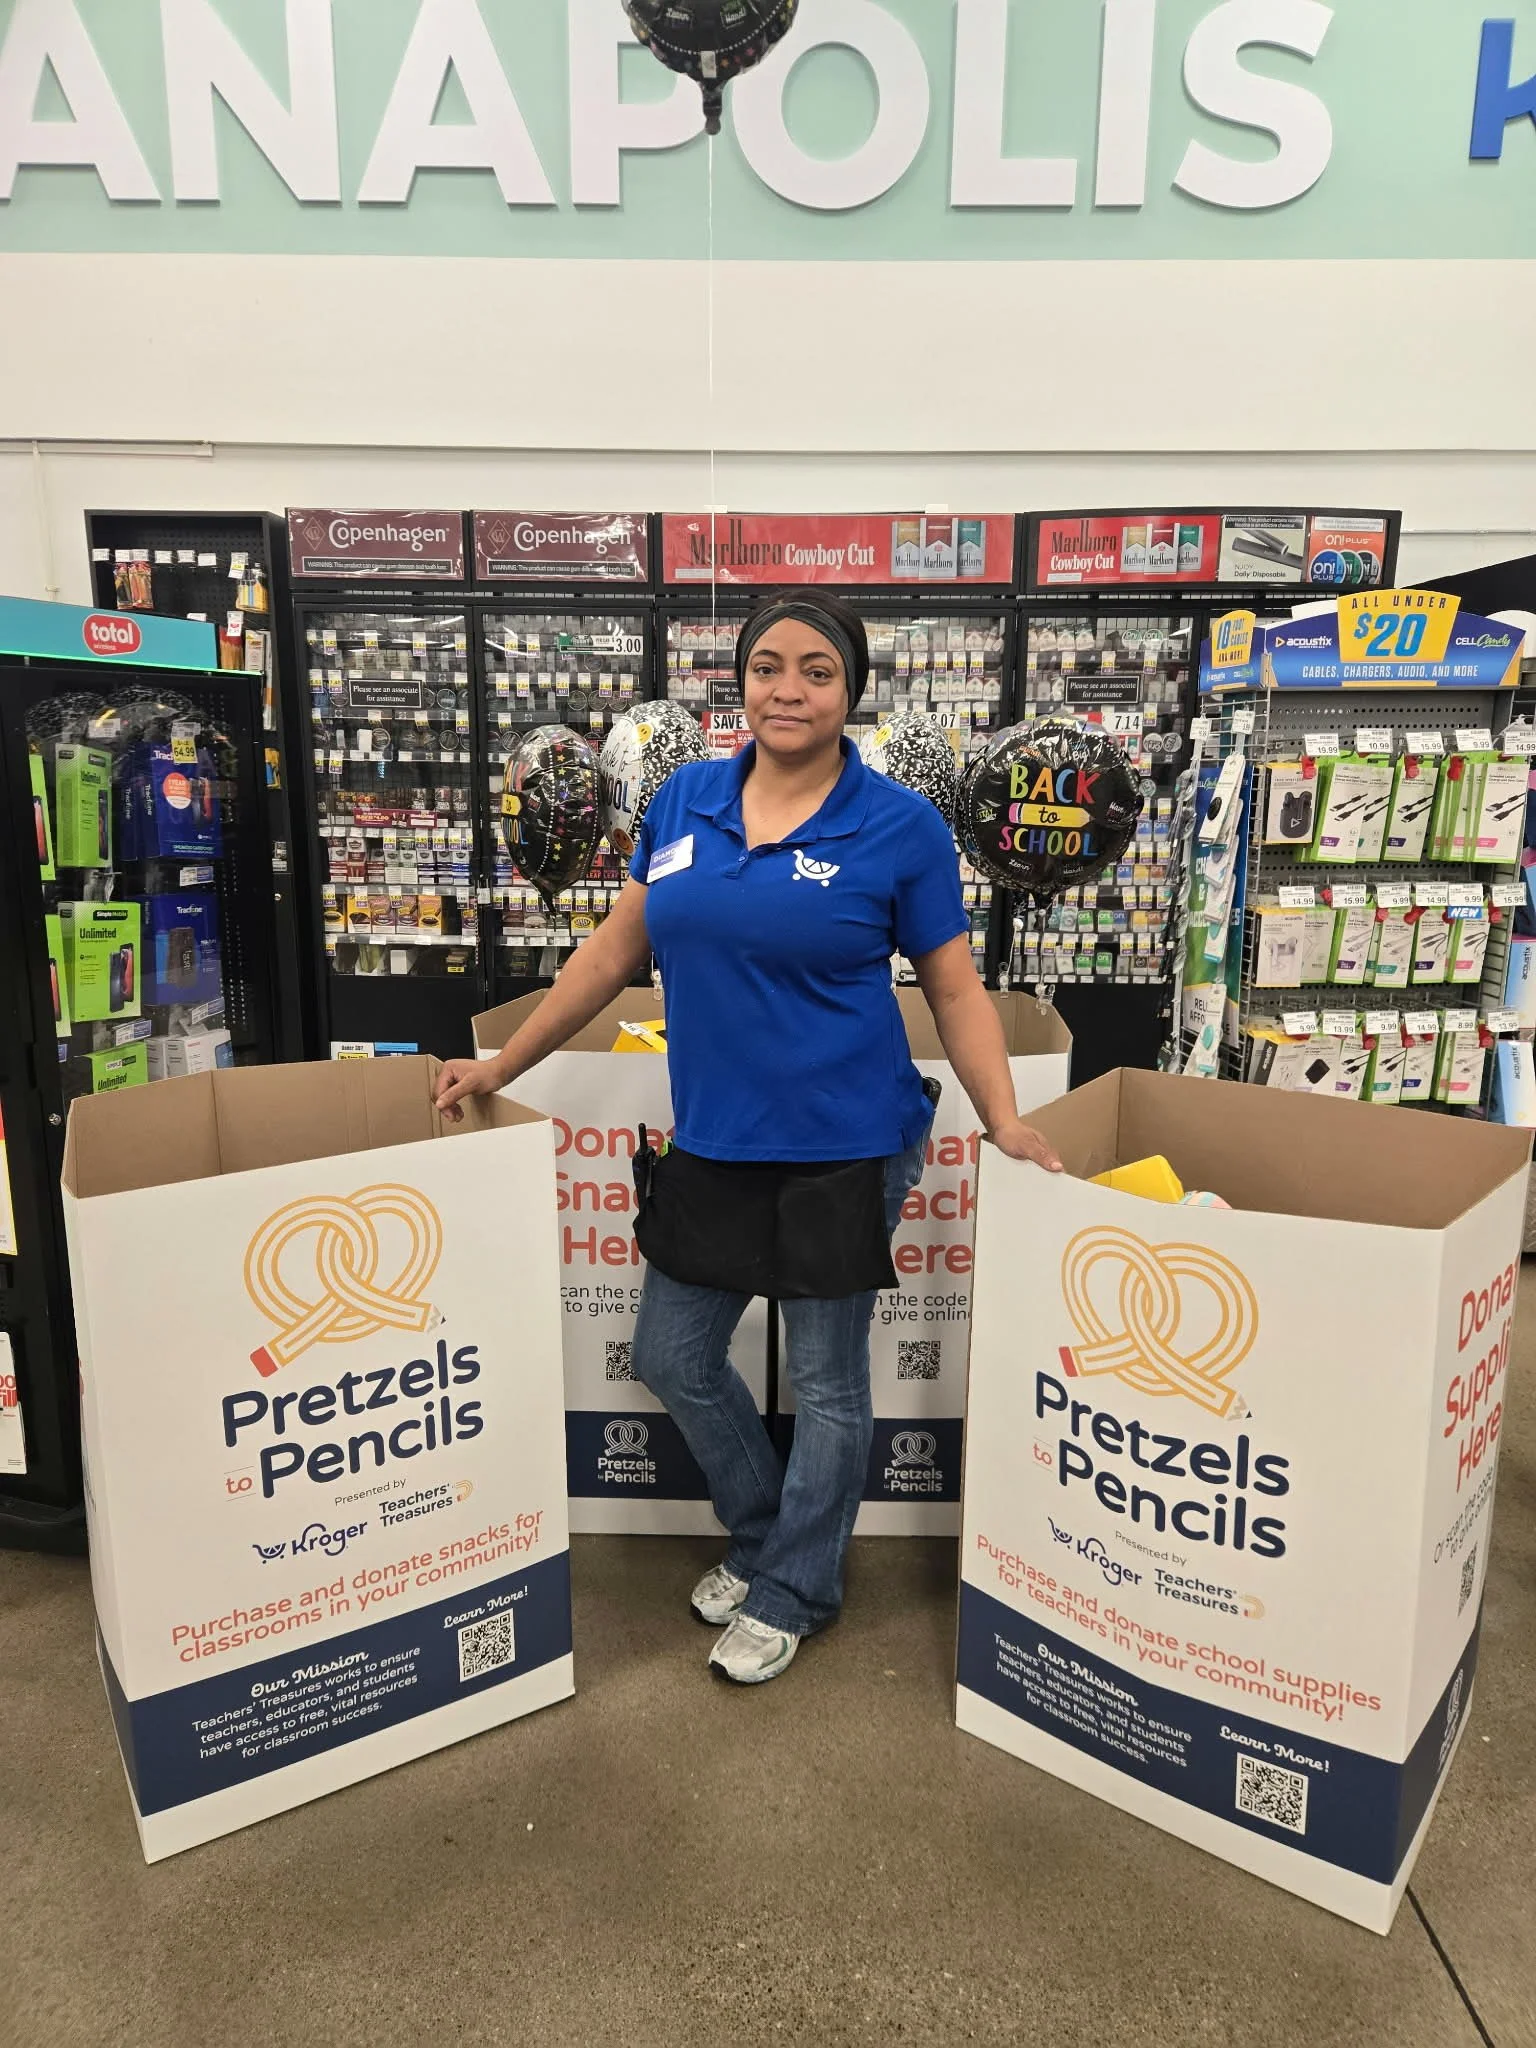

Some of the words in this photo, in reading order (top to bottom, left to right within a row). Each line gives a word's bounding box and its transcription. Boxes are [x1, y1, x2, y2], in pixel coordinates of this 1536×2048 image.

[329, 519, 446, 551] Copenhagen
[514, 522, 630, 554] Copenhagen
[690, 519, 782, 566] Marlboro
[785, 543, 844, 570] Cowboy
[848, 544, 874, 565] Cut
[1052, 520, 1116, 553] Marlboro
[1051, 555, 1092, 573] Cowboy
[1095, 554, 1114, 569] Cut
[1352, 596, 1379, 609] ALL
[1393, 595, 1446, 609] UNDER
[91, 621, 134, 645] total
[616, 638, 641, 652] 3.00
[1287, 636, 1332, 646] acoustix
[1353, 612, 1427, 657] $20
[1431, 665, 1450, 677] AND
[1453, 665, 1478, 677] MORE
[714, 715, 742, 729] SAVE
[1116, 716, 1140, 730] 7.14
[1010, 763, 1100, 804] BACK
[1039, 807, 1060, 824] to
[999, 826, 1098, 856] SCHOOL
[1009, 859, 1030, 870] Learn
[177, 906, 202, 915] Tracfone
[1450, 908, 1479, 917] NEW
[80, 928, 117, 939] Unlimited
[98, 1073, 127, 1090] Unlimited
[895, 1243, 973, 1274] ere
[596, 1285, 623, 1299] the
[889, 1293, 918, 1306] the
[923, 1293, 967, 1307] code
[565, 1300, 582, 1313] to
[589, 1300, 625, 1317] give
[881, 1309, 918, 1324] give
[222, 1339, 481, 1447] Pretzels
[226, 1476, 252, 1495] to
[260, 1396, 484, 1498] Pencils
[1036, 1371, 1289, 1496] Pretzels
[1456, 1401, 1502, 1494] Here
[598, 1457, 656, 1470] Pretzels
[605, 1471, 656, 1483] Pencils
[884, 1468, 943, 1480] Pretzels
[334, 1482, 390, 1506] Presented
[393, 1478, 406, 1491] by
[379, 1483, 450, 1514] Teachers'
[891, 1480, 943, 1492] Pencils
[1033, 1443, 1052, 1466] to
[1059, 1439, 1286, 1558] Pencils
[380, 1495, 453, 1527] Treasures
[291, 1523, 367, 1556] Kroger
[1115, 1531, 1169, 1560] Presented
[1172, 1552, 1188, 1567] by
[172, 1596, 291, 1645] Purchase
[300, 1577, 345, 1606] and
[352, 1552, 432, 1589] donate
[439, 1523, 509, 1560] snacks
[515, 1509, 543, 1534] for
[1077, 1538, 1142, 1586] Kroger
[179, 1609, 322, 1662] classrooms
[329, 1598, 350, 1616] in
[358, 1580, 409, 1611] your
[415, 1527, 539, 1588] community!
[1155, 1568, 1237, 1600] Teachers'
[1155, 1581, 1238, 1616] Treasures
[443, 1606, 485, 1628] Learn
[488, 1586, 529, 1610] More!
[977, 1534, 1057, 1592] Purchase
[1062, 1583, 1098, 1614] and
[1104, 1607, 1179, 1651] donate
[1186, 1639, 1265, 1677] school
[1272, 1664, 1381, 1711] supplies
[997, 1564, 1025, 1592] for
[1027, 1583, 1107, 1637] teachers
[1113, 1629, 1131, 1651] in
[1136, 1646, 1189, 1673] your
[1195, 1662, 1344, 1723] community!
[192, 1703, 256, 1732] Teachers'
[259, 1683, 321, 1709] Treasures
[325, 1669, 361, 1687] works
[365, 1663, 377, 1673] to
[380, 1647, 421, 1668] ensure
[251, 1679, 289, 1697] Our
[292, 1651, 369, 1684] Mission
[994, 1633, 1041, 1667] Teachers'
[1044, 1660, 1094, 1698] Treasures
[1096, 1690, 1130, 1716] works
[1133, 1709, 1145, 1724] to
[1148, 1717, 1192, 1742] ensure
[1038, 1643, 1068, 1669] Our
[1070, 1660, 1139, 1707] Mission
[200, 1743, 232, 1758] have
[236, 1726, 279, 1747] access
[283, 1720, 296, 1731] to
[299, 1708, 328, 1727] free,
[331, 1696, 357, 1713] vital
[360, 1675, 417, 1702] resources
[201, 1718, 262, 1744] teachers,
[266, 1694, 333, 1722] educators,
[336, 1681, 360, 1696] and
[363, 1662, 415, 1687] students
[996, 1661, 1020, 1682] have
[1023, 1680, 1057, 1703] access
[1059, 1696, 1071, 1711] to
[1073, 1703, 1098, 1727] free,
[1100, 1718, 1124, 1739] vital
[1127, 1733, 1187, 1767] resources
[999, 1651, 1044, 1685] teachers,
[1047, 1679, 1103, 1714] educators,
[1106, 1709, 1127, 1728] and
[1130, 1721, 1185, 1753] students
[241, 1746, 259, 1758] for
[264, 1722, 328, 1750] classroom
[332, 1702, 383, 1725] success.
[1026, 1691, 1041, 1706] for
[1043, 1702, 1098, 1738] classroom
[1100, 1733, 1148, 1764] success.
[1220, 1725, 1271, 1753] Learn
[1274, 1744, 1329, 1773] More!
